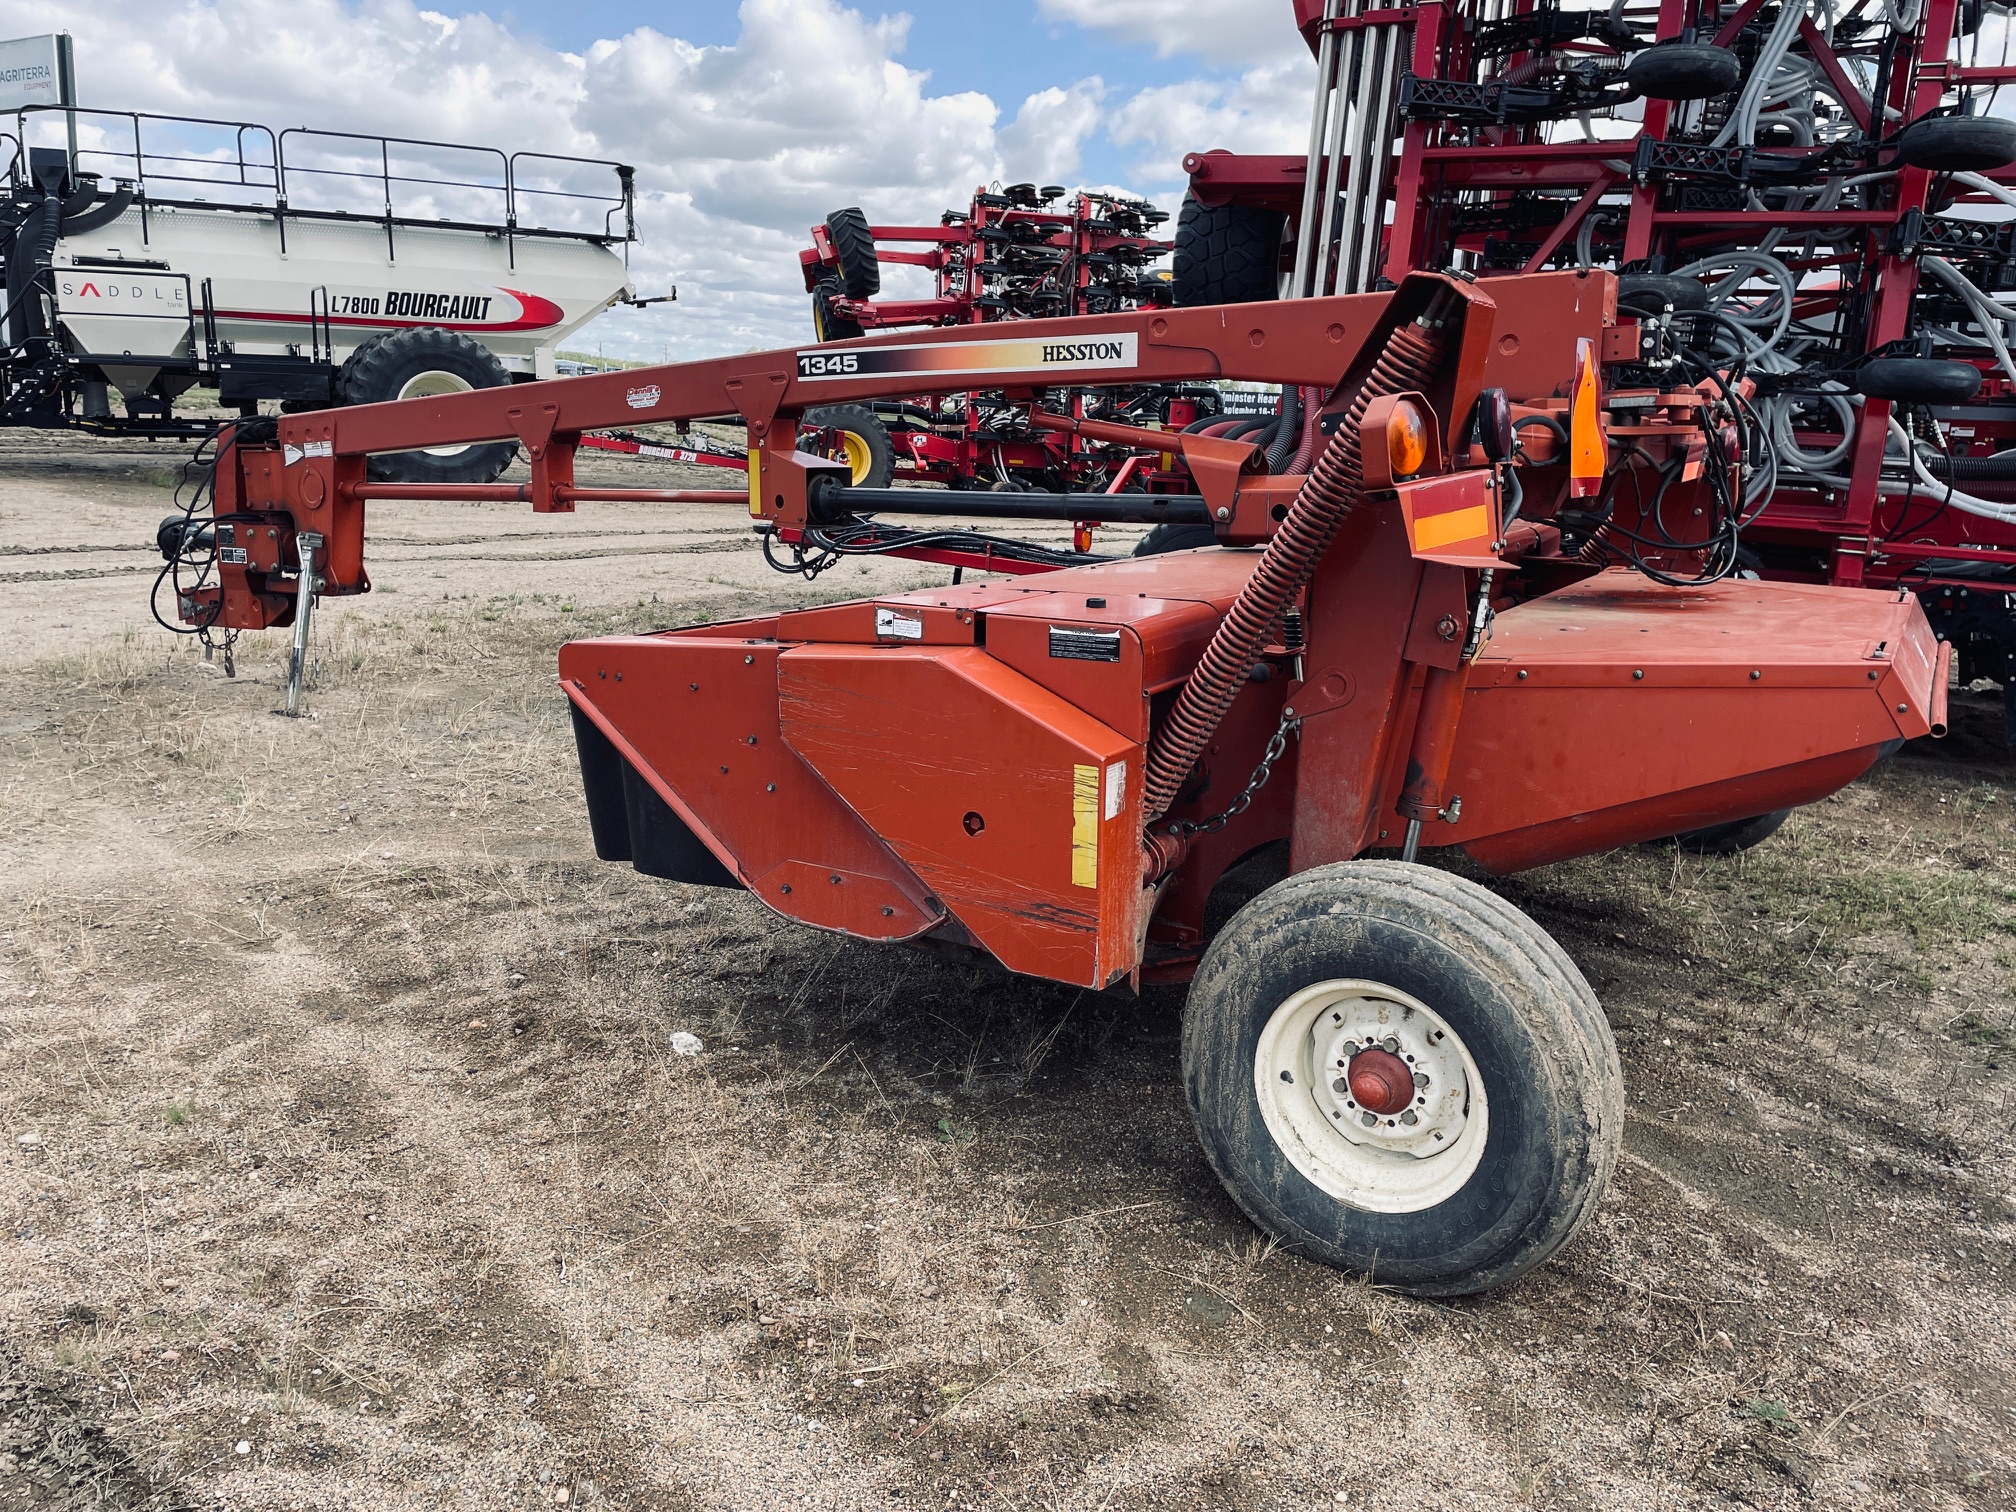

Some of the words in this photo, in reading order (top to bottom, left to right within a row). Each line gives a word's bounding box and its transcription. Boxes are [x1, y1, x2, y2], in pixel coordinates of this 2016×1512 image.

[0, 65, 51, 82] AGRITERRA
[24, 81, 51, 90] EQUIPMENT
[63, 282, 184, 300] SADDLE
[331, 295, 380, 314] L7800
[384, 291, 492, 320] BOURGAULT
[799, 354, 858, 375] 1345
[1042, 342, 1123, 362] HESSTON
[638, 444, 675, 459] BOURGAULT
[679, 450, 698, 462] 3720
